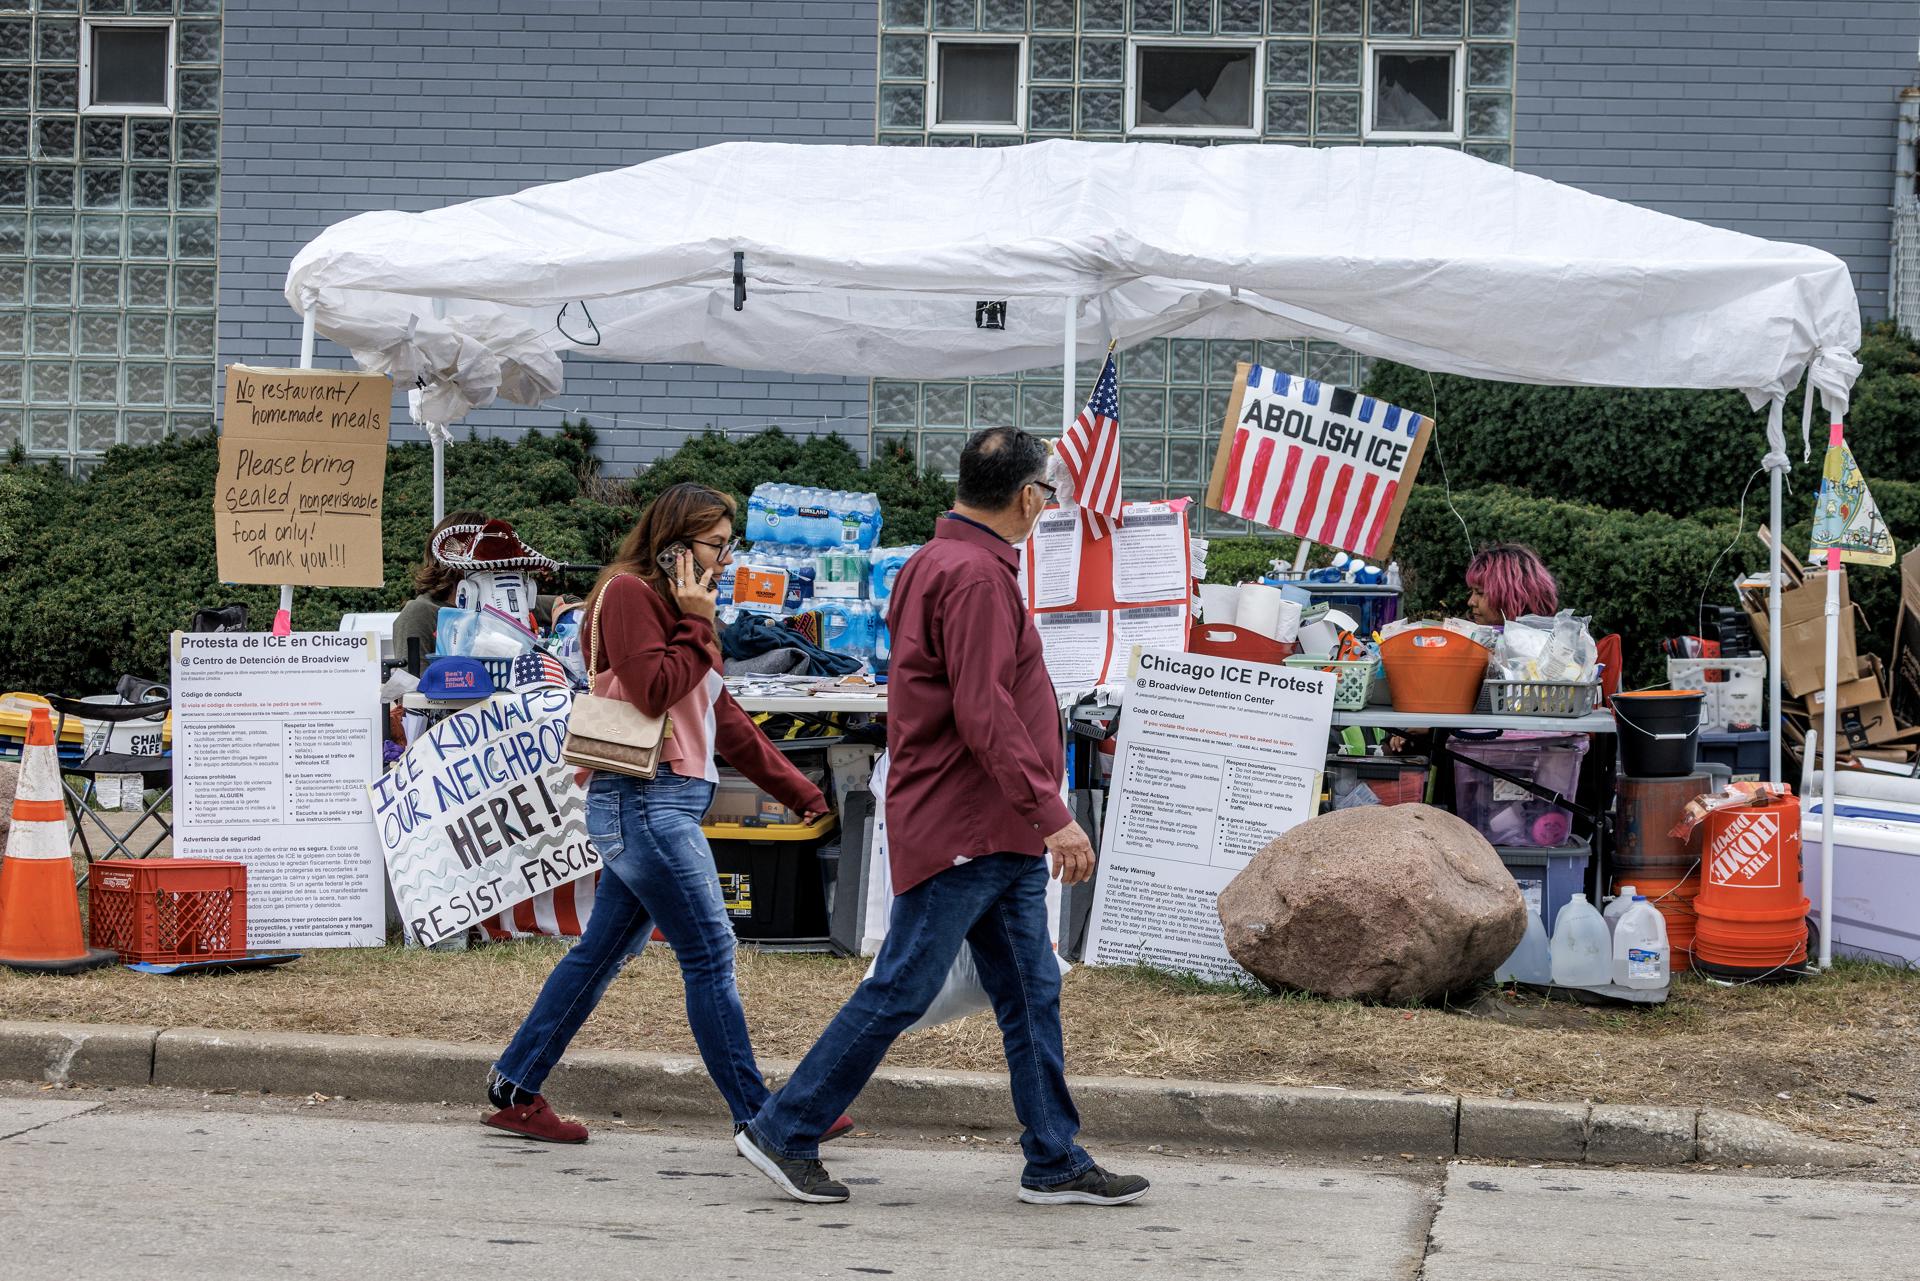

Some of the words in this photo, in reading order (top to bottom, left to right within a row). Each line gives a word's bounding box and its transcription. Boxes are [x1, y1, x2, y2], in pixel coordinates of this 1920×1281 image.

[236, 377, 255, 400] No
[262, 378, 360, 405] restaurant/
[252, 405, 323, 426] homemade
[332, 408, 381, 430] meals
[1242, 398, 1363, 458] ABOLISH
[1364, 436, 1408, 472] ICE
[236, 449, 296, 480] Please
[301, 450, 354, 486] bring
[300, 491, 378, 516] nonperishable
[232, 520, 266, 544] food
[275, 522, 316, 548] only!
[248, 546, 294, 568] Thank
[301, 544, 346, 574] you!!!
[182, 637, 239, 648] Protesta
[242, 636, 259, 647] de
[263, 636, 286, 647] ICE
[291, 637, 306, 646] en
[311, 634, 367, 648] Chicago
[239, 656, 284, 664] Detención
[301, 655, 349, 663] Broadview
[1141, 653, 1215, 680] Chicago
[1220, 665, 1252, 684] ICE
[1257, 670, 1323, 694] Protest
[1148, 679, 1196, 693] Broadview
[1198, 687, 1241, 700] Detention
[1244, 694, 1274, 705] Center
[1158, 711, 1184, 720] Conduct
[131, 744, 159, 755] SAFE
[372, 746, 424, 815] ICE
[428, 690, 568, 761] KIDNAPS
[1247, 762, 1276, 770] boundaries
[384, 788, 432, 849] OUR
[432, 714, 570, 812] NEIGHBOR
[1122, 788, 1148, 796] Prohibited
[444, 775, 562, 870] HERE!
[1711, 814, 1778, 884] HOME
[1110, 864, 1129, 873] Safety
[1130, 867, 1155, 877] Warning
[1740, 850, 1772, 880] THE
[410, 876, 502, 944] RESIST
[520, 839, 599, 894] FASCIS
[1153, 948, 1187, 956] recommend
[1200, 954, 1215, 962] bring
